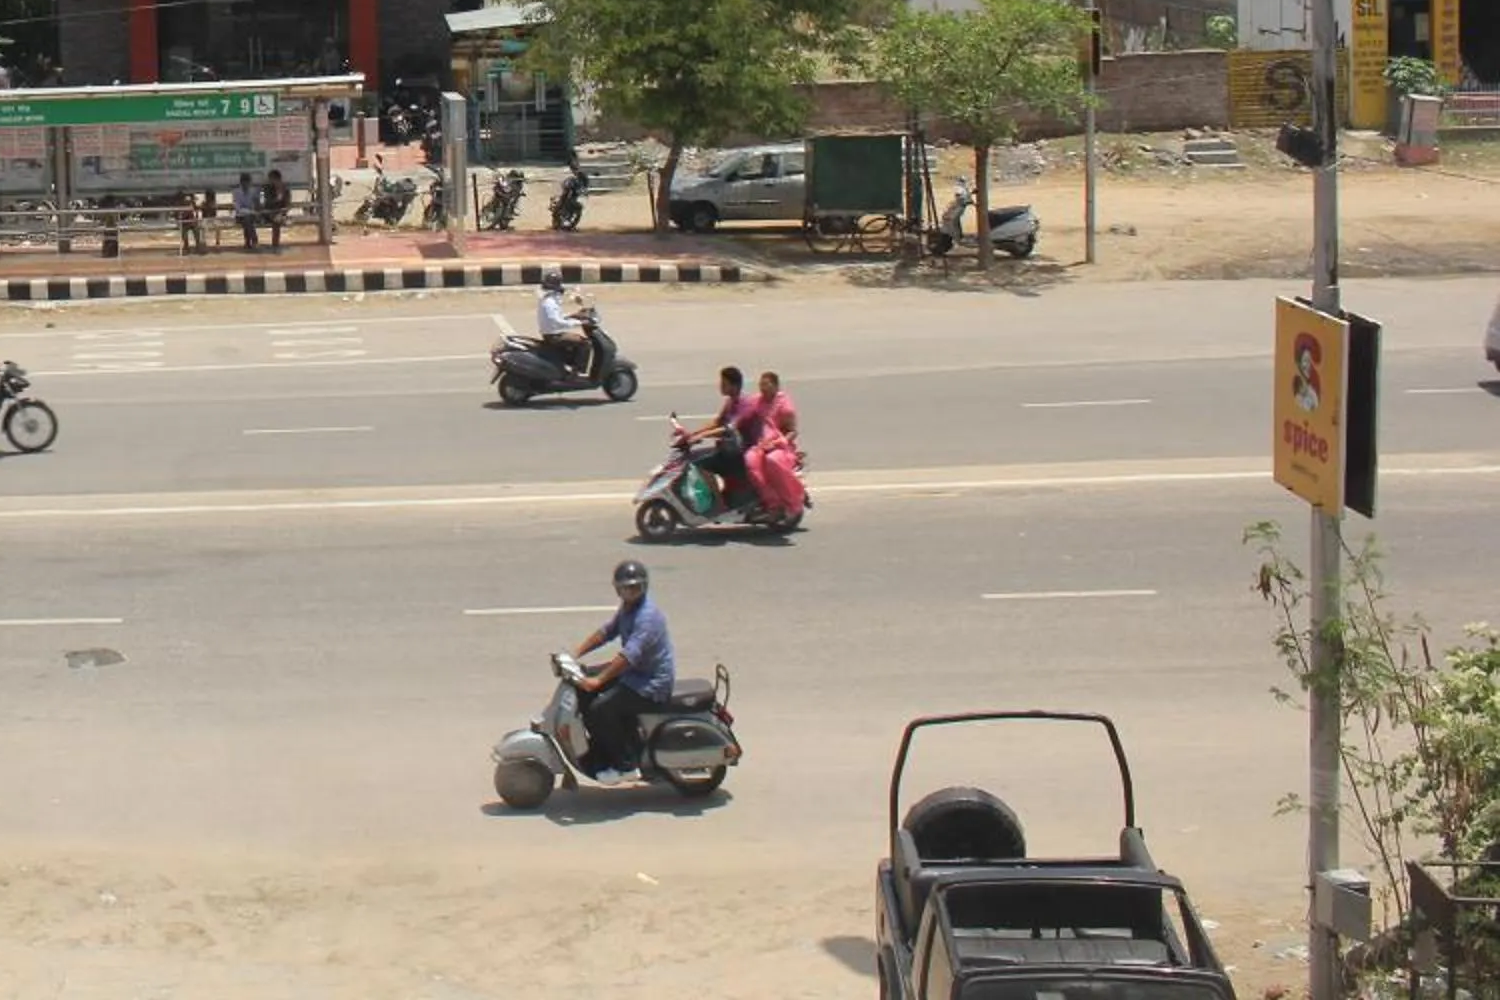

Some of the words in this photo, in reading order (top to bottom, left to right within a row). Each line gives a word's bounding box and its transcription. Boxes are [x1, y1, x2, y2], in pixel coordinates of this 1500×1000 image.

[219, 99, 231, 116] 7
[240, 98, 251, 115] 9
[1283, 419, 1329, 465] spice
